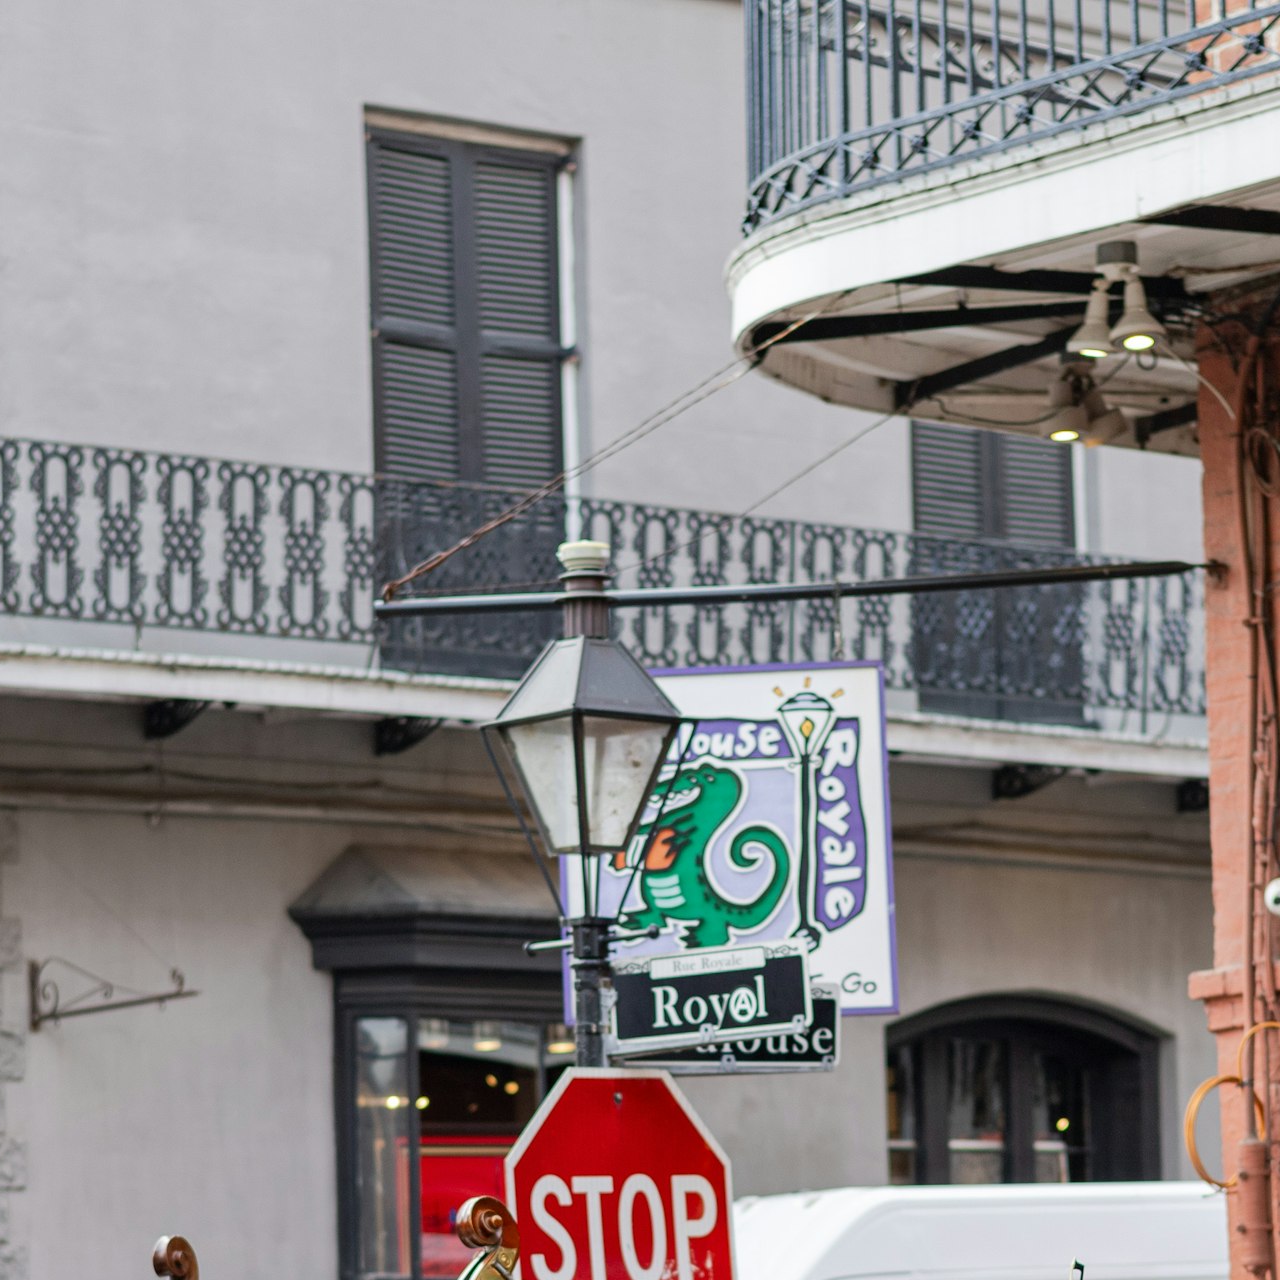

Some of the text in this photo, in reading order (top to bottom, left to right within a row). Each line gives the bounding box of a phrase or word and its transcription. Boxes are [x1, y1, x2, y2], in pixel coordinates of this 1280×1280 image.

[816, 728, 862, 922] Royale
[673, 954, 744, 973] Rue Royale
[651, 974, 769, 1031] Royl
